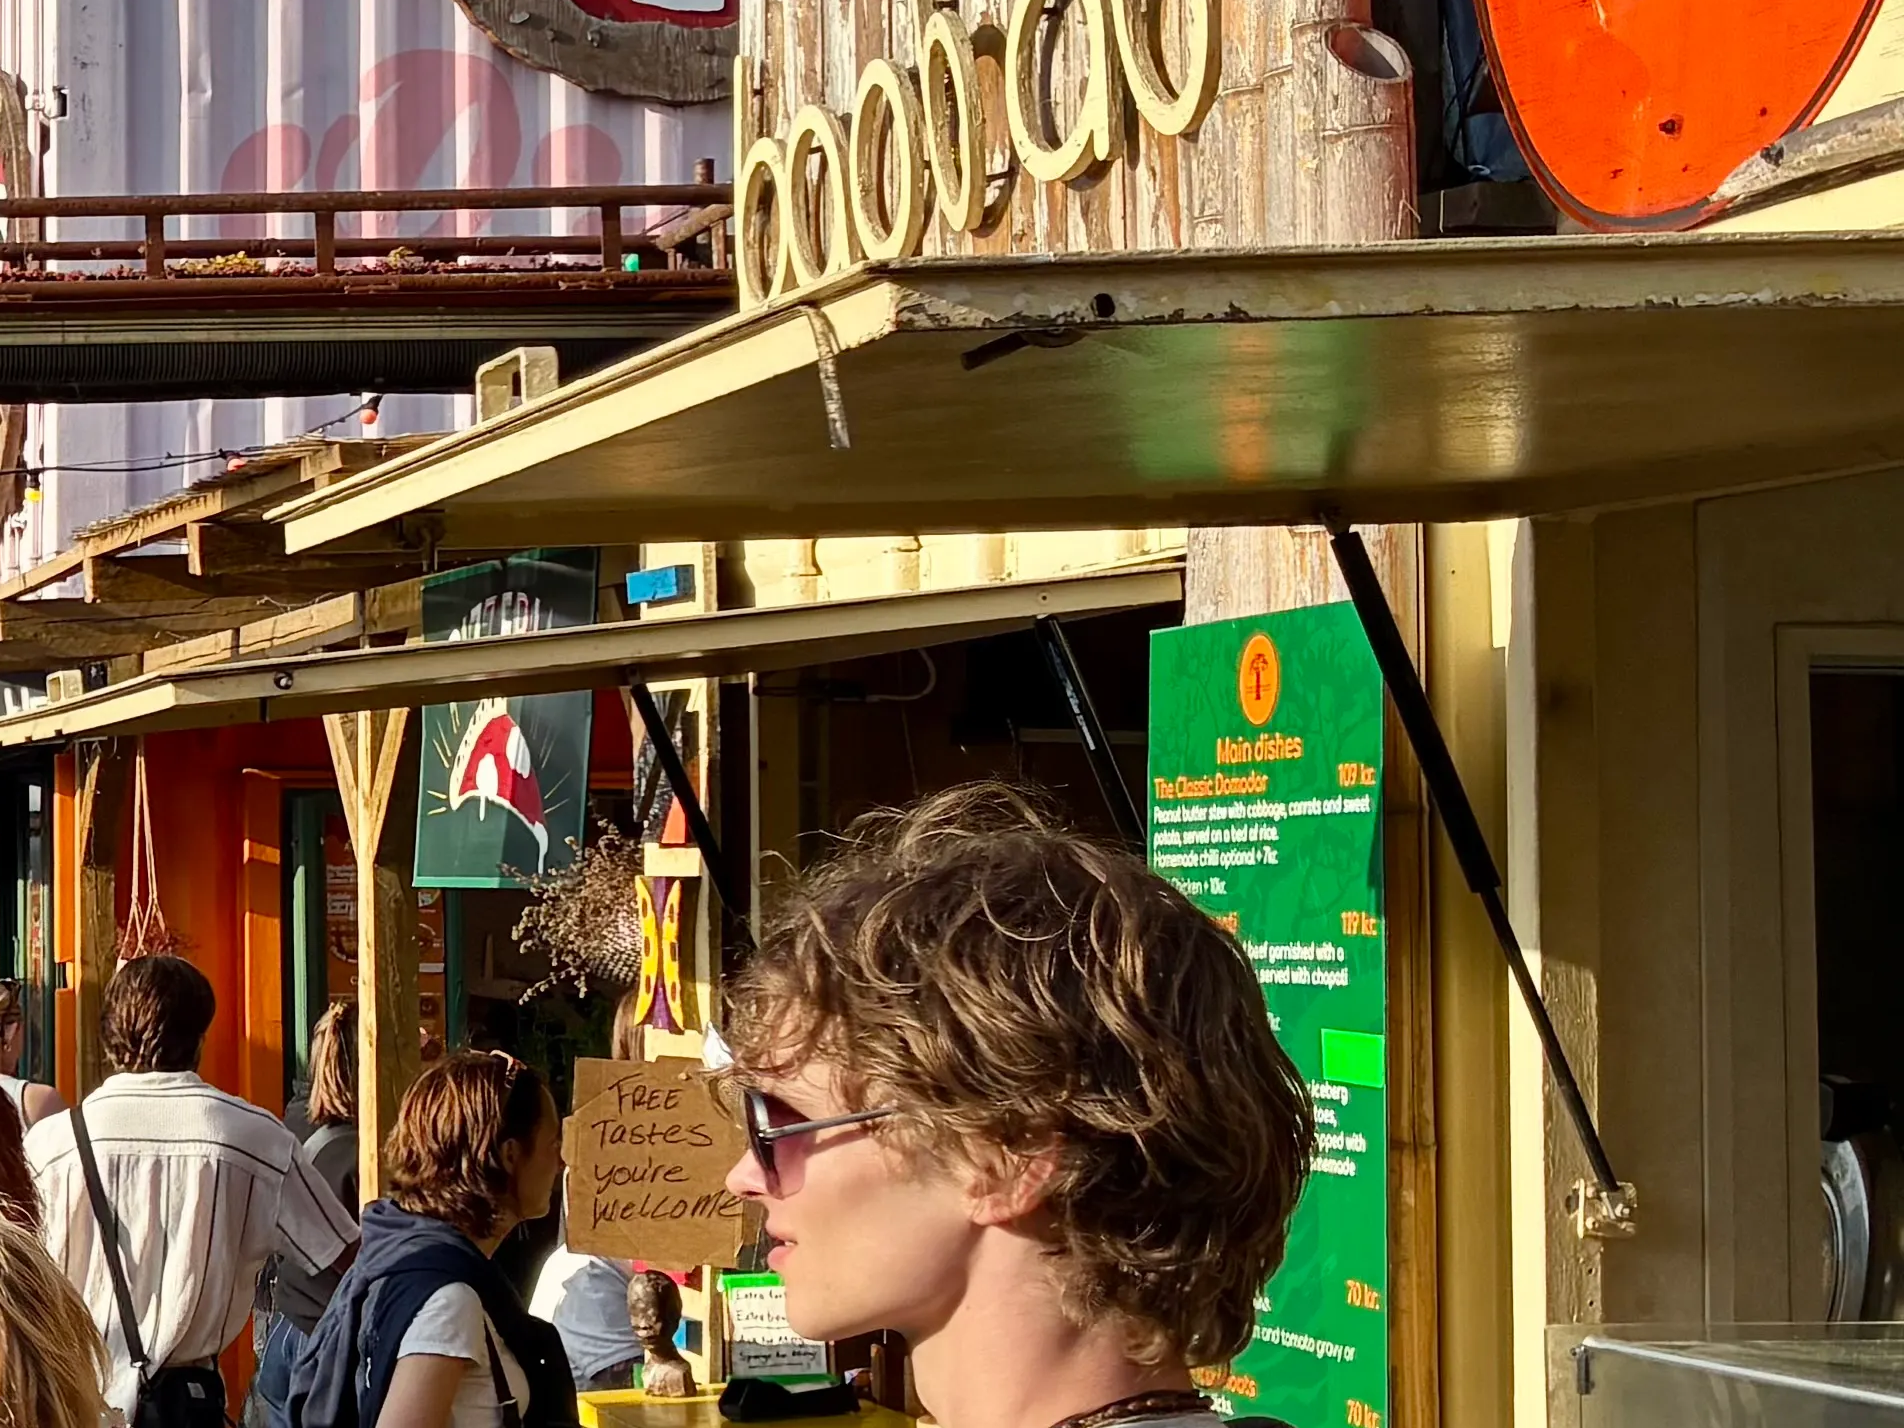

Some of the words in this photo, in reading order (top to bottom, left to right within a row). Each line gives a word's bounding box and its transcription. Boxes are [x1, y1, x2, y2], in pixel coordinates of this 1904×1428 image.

[1217, 737, 1252, 765] Main
[1254, 733, 1303, 761] dishes
[608, 1073, 684, 1116] FREE
[591, 1119, 712, 1151] Tastes
[594, 1156, 691, 1194] you're
[1347, 1280, 1362, 1307] 70
[1347, 1400, 1362, 1426] 70
